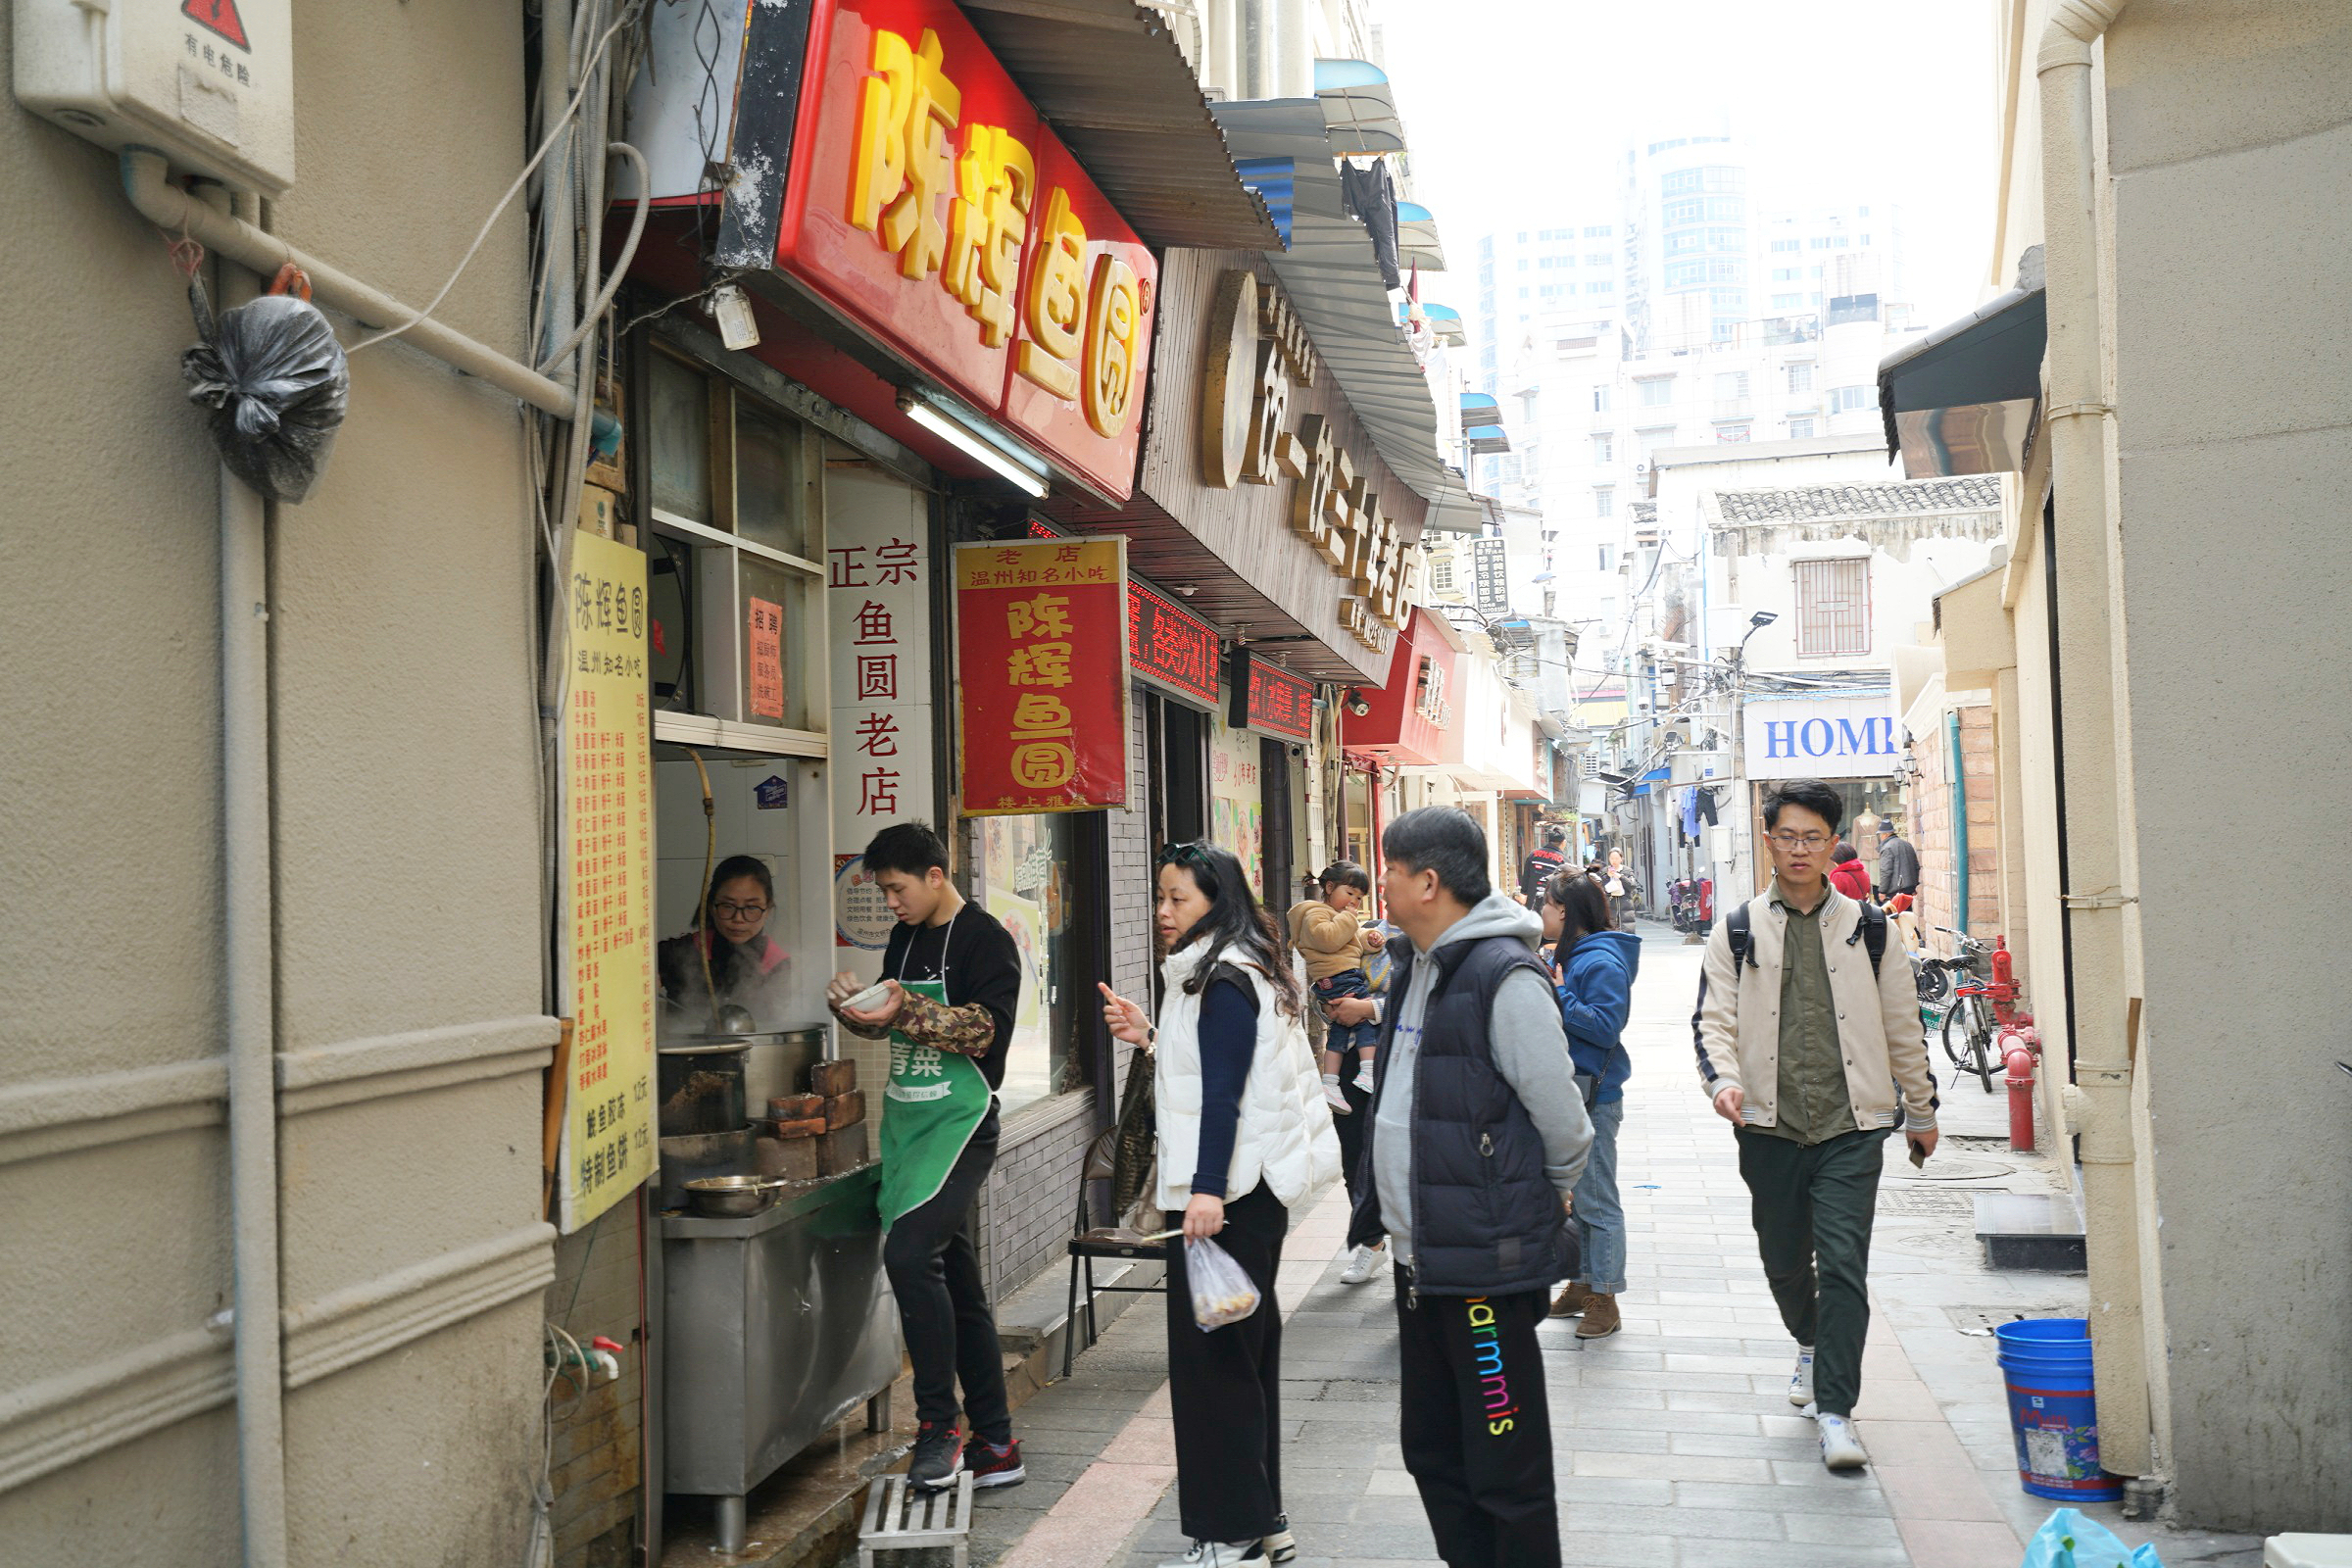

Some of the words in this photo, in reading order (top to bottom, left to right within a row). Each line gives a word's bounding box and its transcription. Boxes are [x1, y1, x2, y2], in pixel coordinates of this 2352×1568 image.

[183, 32, 252, 89] 有电危险
[846, 27, 1140, 439] 陈辉鱼圆
[827, 537, 918, 589] 正宗
[970, 566, 1109, 586] 温州知名小吃
[996, 545, 1081, 565] 老店
[573, 571, 644, 640] 陈辉鱼圆
[577, 650, 643, 679] 温州知名小吃
[1005, 592, 1075, 789] 陈辉鱼圆
[853, 599, 901, 816] 鱼圆老店
